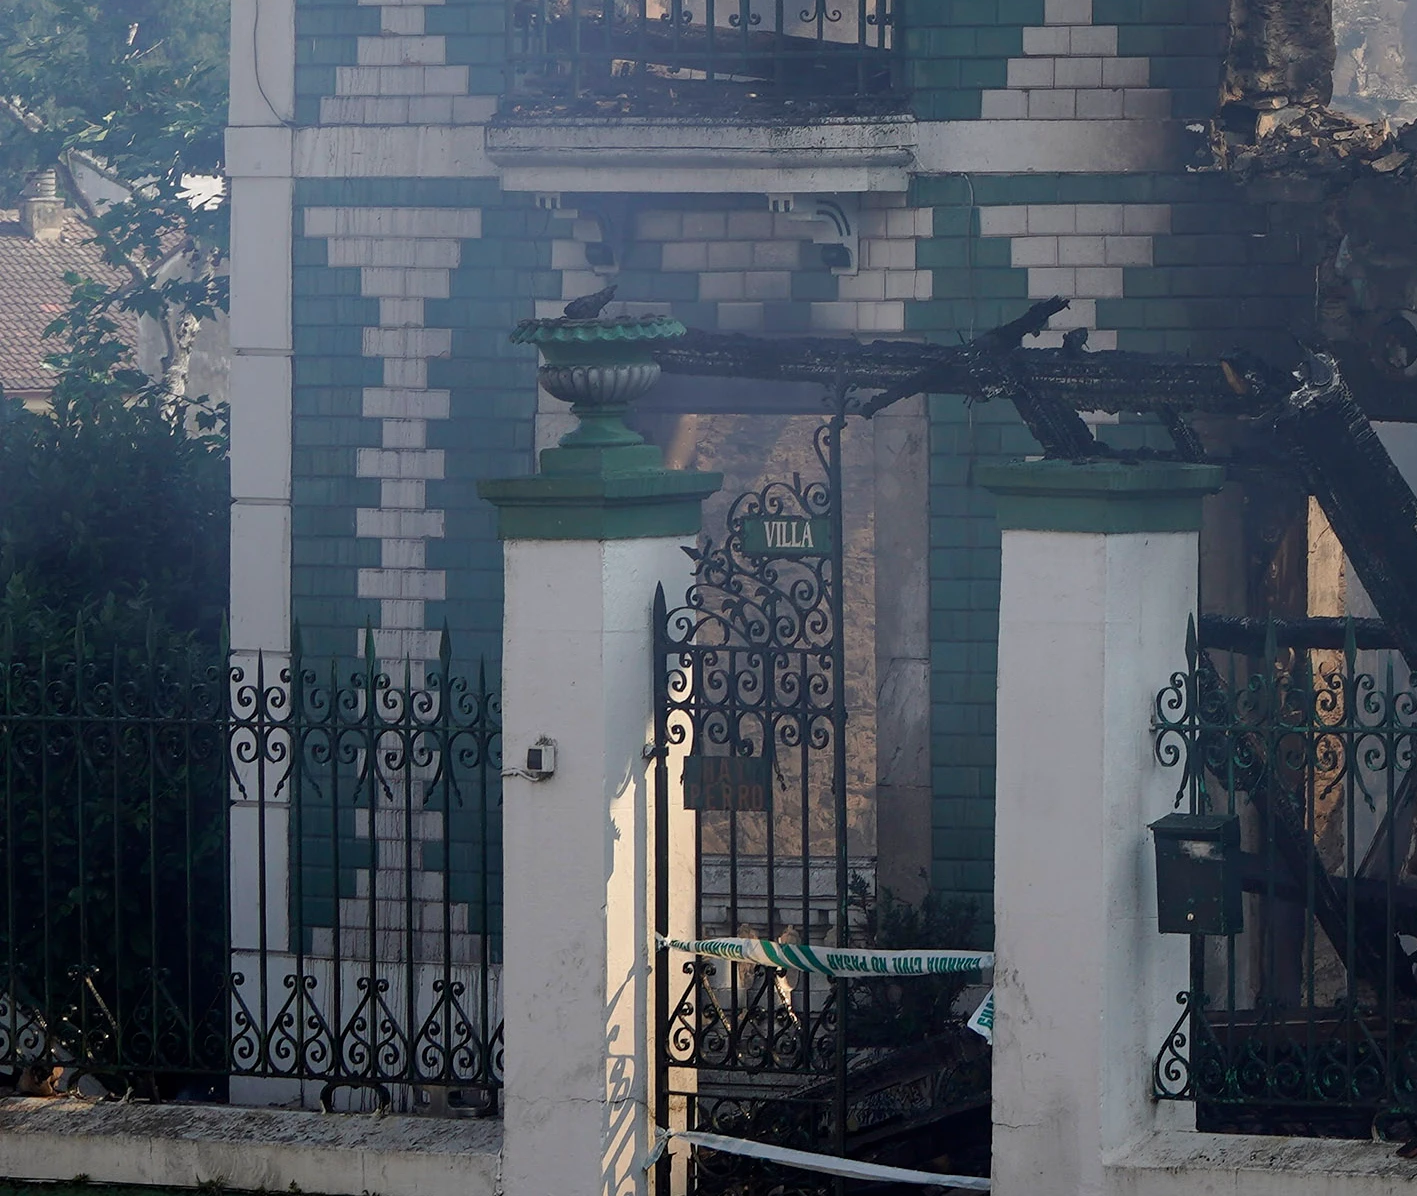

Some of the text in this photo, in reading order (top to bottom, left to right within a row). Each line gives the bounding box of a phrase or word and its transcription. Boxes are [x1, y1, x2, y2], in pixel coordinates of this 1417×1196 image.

[764, 521, 814, 547] VILLA
[826, 954, 868, 972] PASAR
[871, 957, 889, 973] NO
[892, 957, 923, 974] CIVIL
